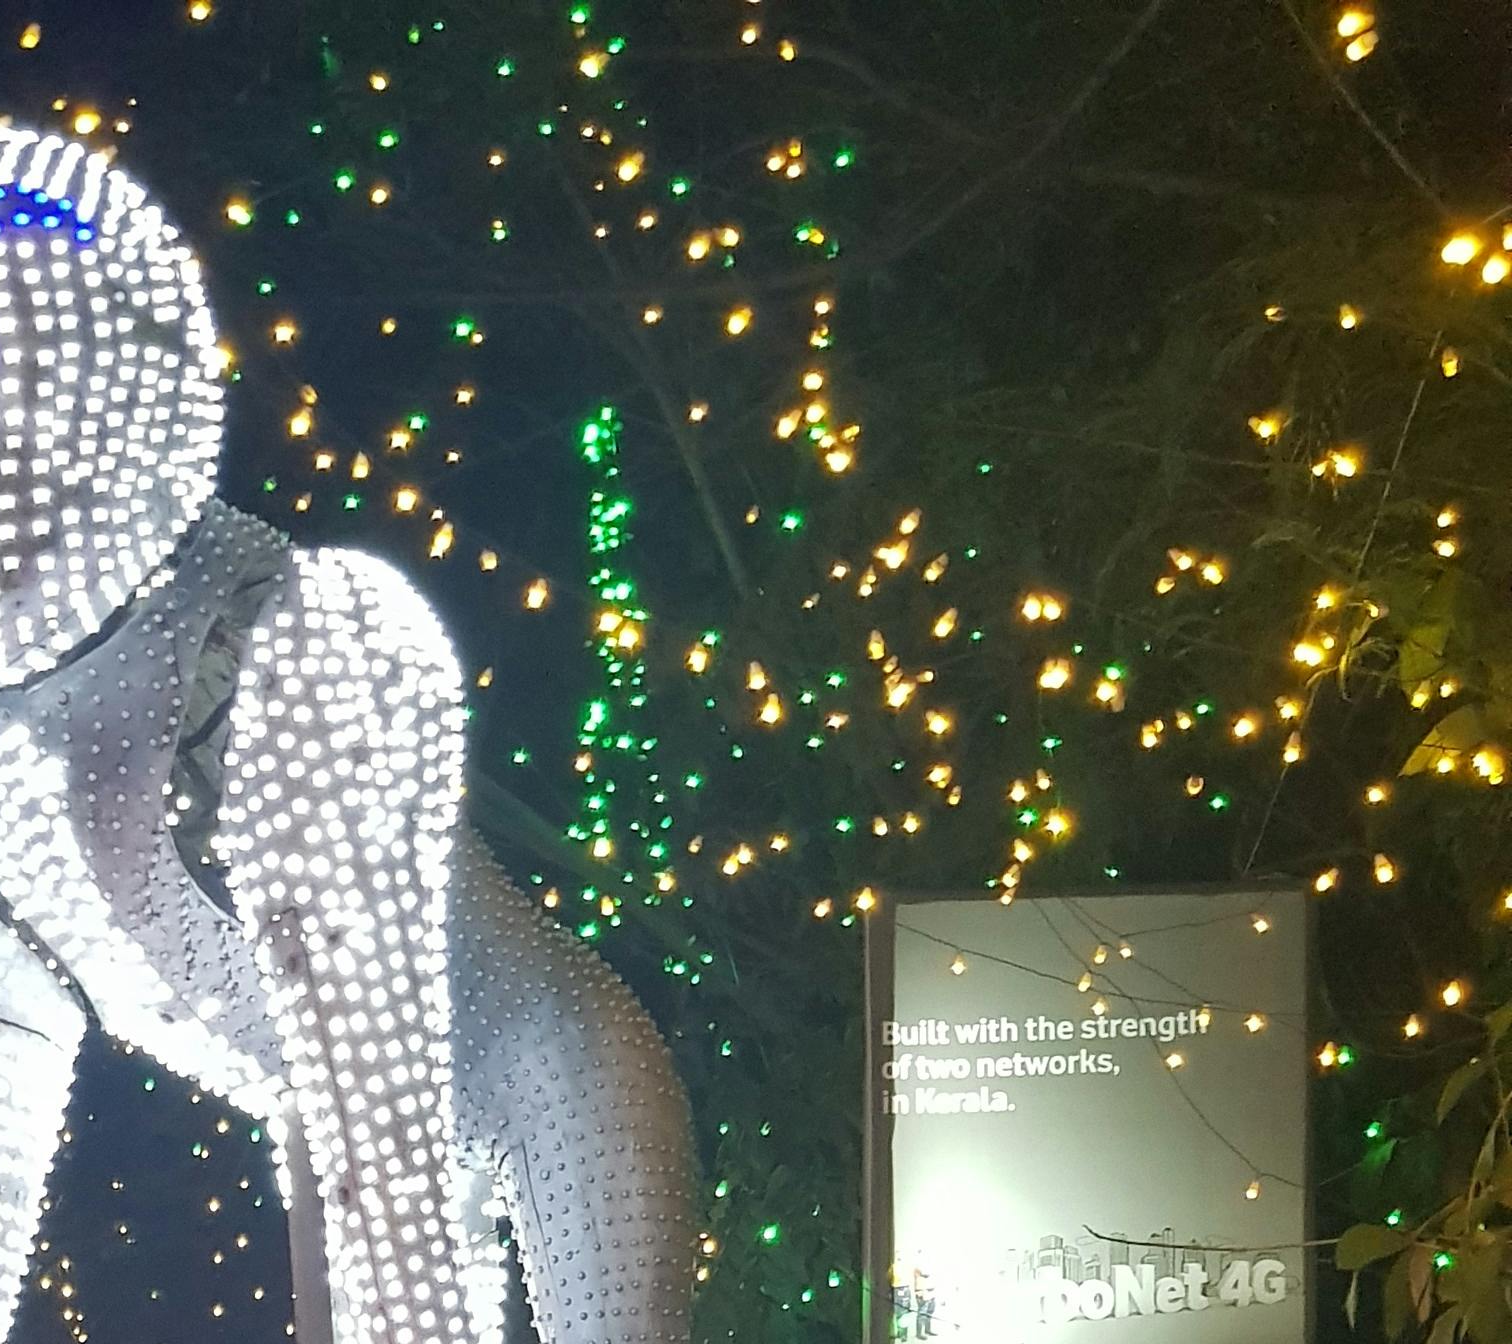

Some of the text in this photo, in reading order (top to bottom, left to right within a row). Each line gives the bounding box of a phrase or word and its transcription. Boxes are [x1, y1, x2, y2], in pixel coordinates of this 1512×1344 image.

[882, 1009, 1206, 1047] Built with the strength
[882, 1048, 1121, 1080] of two networks,
[882, 1086, 1016, 1114] in Kerala.
[1219, 1258, 1287, 1307] 4G
